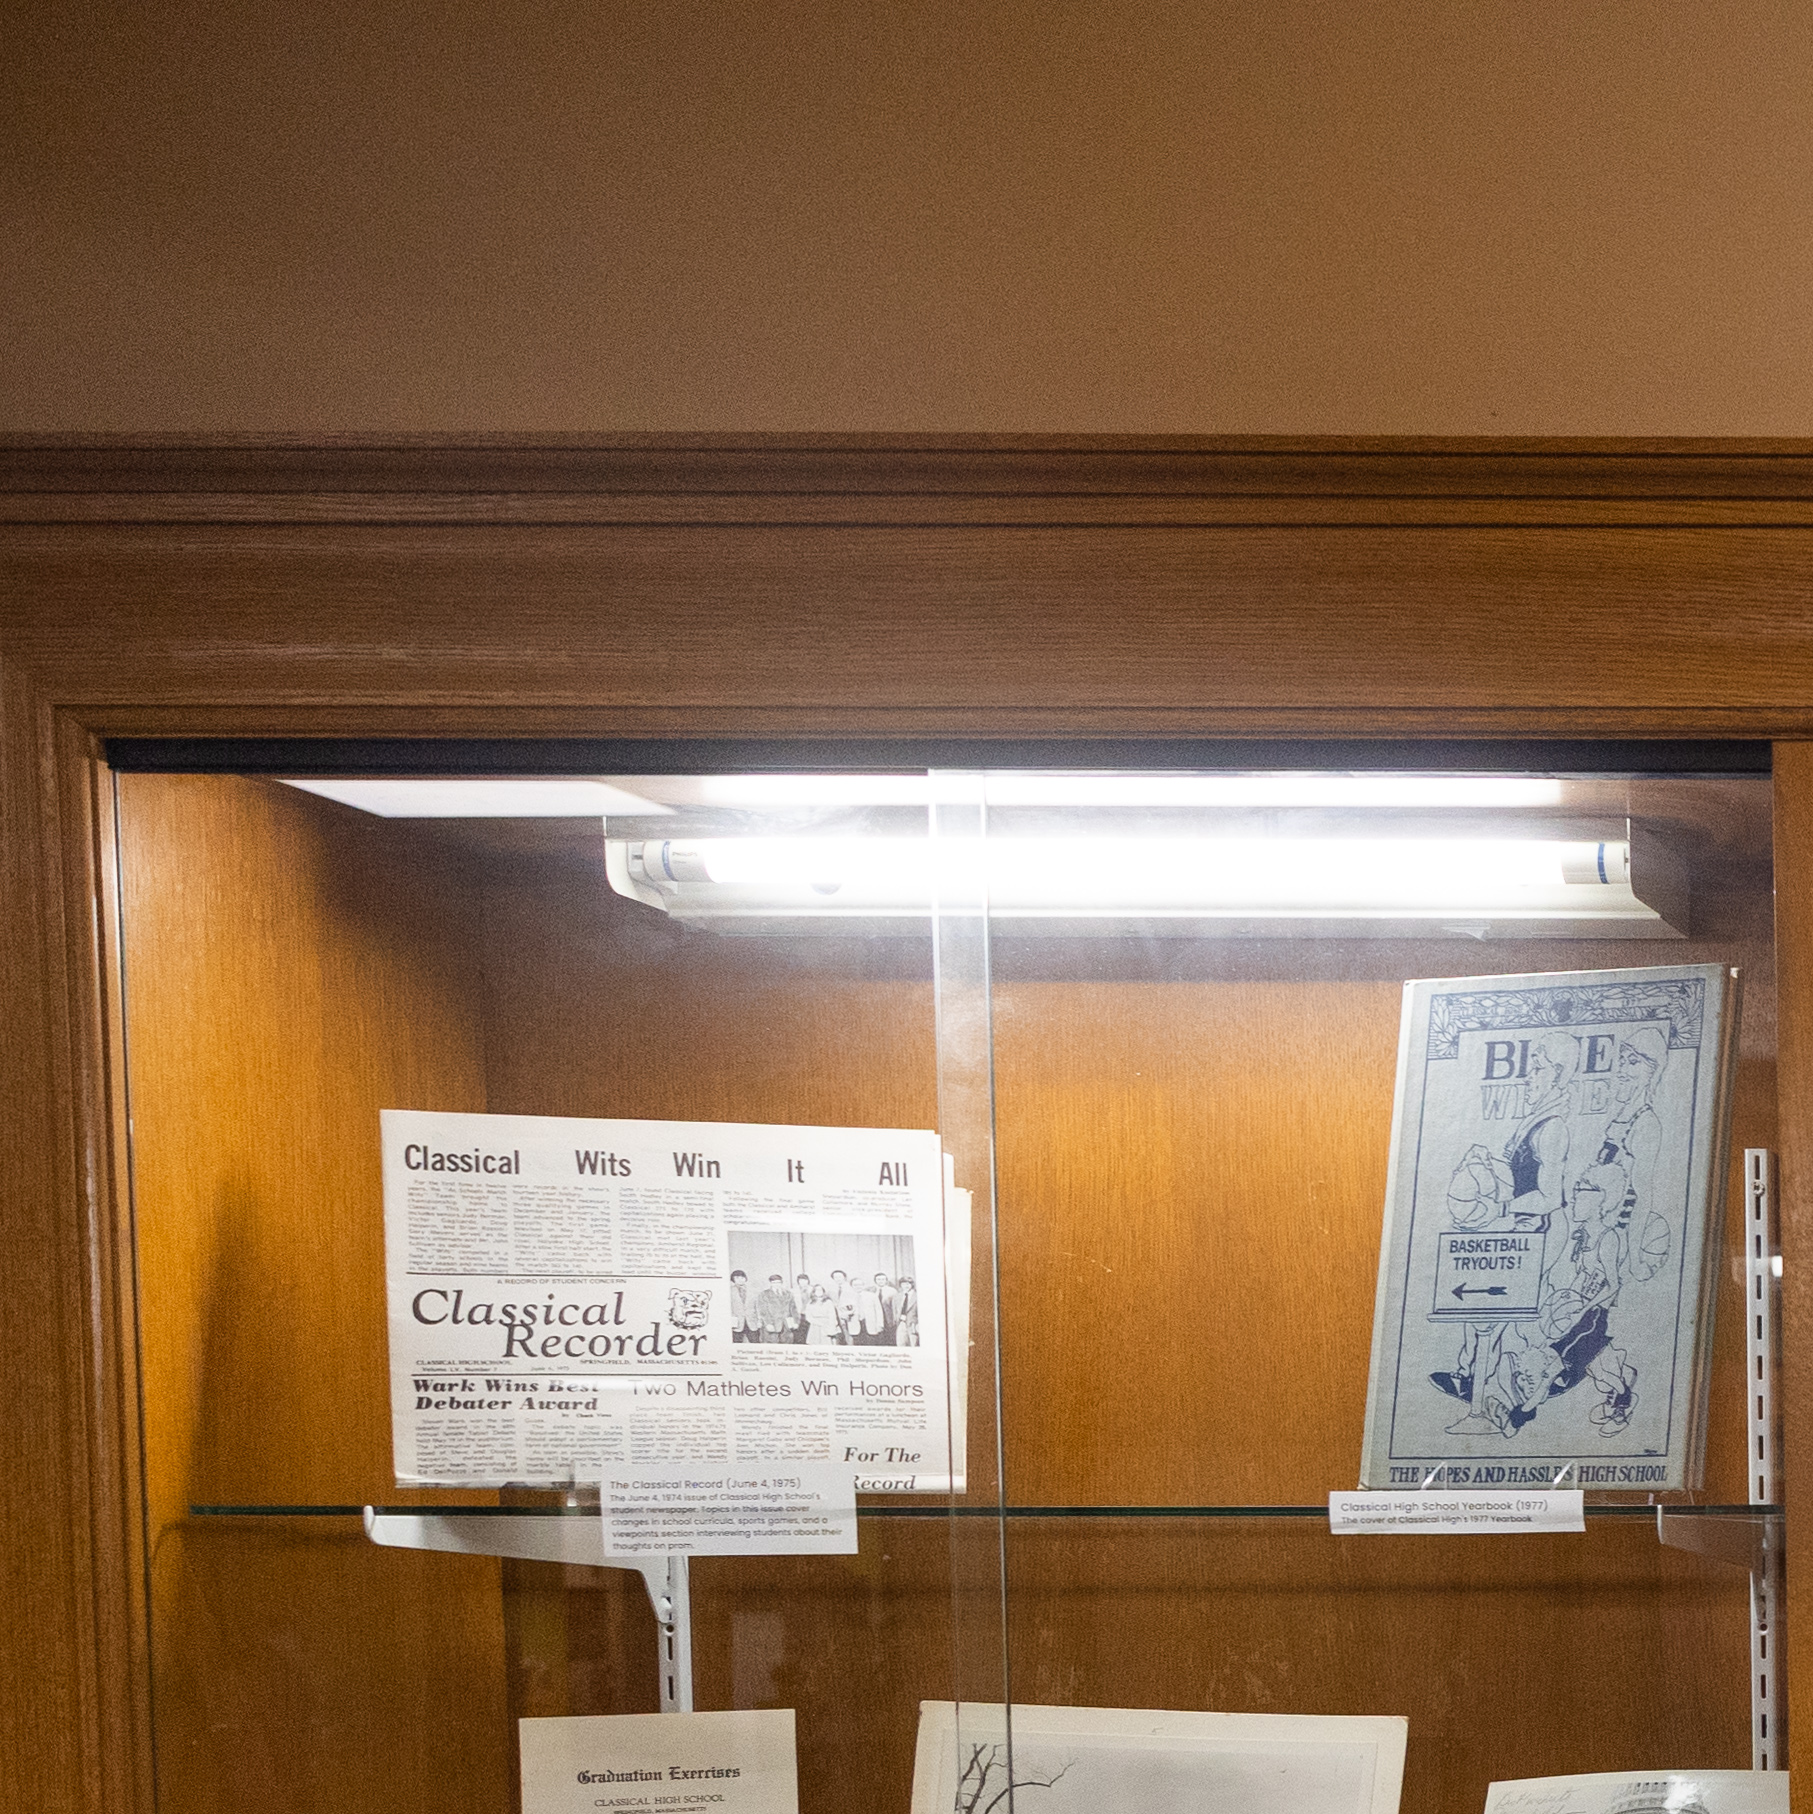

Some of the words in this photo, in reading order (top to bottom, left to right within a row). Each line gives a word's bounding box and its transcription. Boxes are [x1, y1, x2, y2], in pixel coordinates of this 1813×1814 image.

[404, 1143, 520, 1175] Classical
[575, 1149, 632, 1177] Wits
[672, 1151, 721, 1178] Win
[787, 1158, 805, 1183] It
[878, 1161, 908, 1186] All
[1449, 1237, 1530, 1256] BASKETBALL
[1453, 1255, 1522, 1270] TRYOUTS!
[411, 1287, 625, 1327] Classical
[501, 1321, 709, 1359] Recorder
[412, 1378, 475, 1392] Wark
[485, 1378, 538, 1392] Wins
[629, 1379, 676, 1396] Two
[687, 1379, 791, 1397] Mathletes
[800, 1379, 839, 1396] Win
[849, 1379, 925, 1399] Honors
[415, 1396, 512, 1409] Debater
[520, 1396, 598, 1411] Award
[843, 1446, 879, 1462] For
[884, 1446, 921, 1463] The
[609, 1480, 630, 1489] The
[631, 1479, 682, 1489] Classical
[684, 1479, 723, 1489] Record
[726, 1477, 758, 1490] (June
[760, 1478, 770, 1489] 4,
[772, 1476, 801, 1489] 1975)
[1389, 1467, 1419, 1483] THE
[1472, 1467, 1506, 1484] AND
[1577, 1466, 1616, 1482] HIGH
[1617, 1465, 1667, 1482] SCHOOL
[1340, 1502, 1391, 1512] Classical
[1394, 1502, 1419, 1513] High
[1422, 1501, 1459, 1512] School
[1461, 1501, 1512, 1512] Yearbook
[1516, 1499, 1548, 1512] (1977)
[576, 1768, 662, 1785] Graduation
[668, 1765, 740, 1780] Exercises
[594, 1797, 650, 1807] CLASSICAL
[654, 1795, 680, 1804] HIGH
[683, 1793, 725, 1803] SCHOOL
